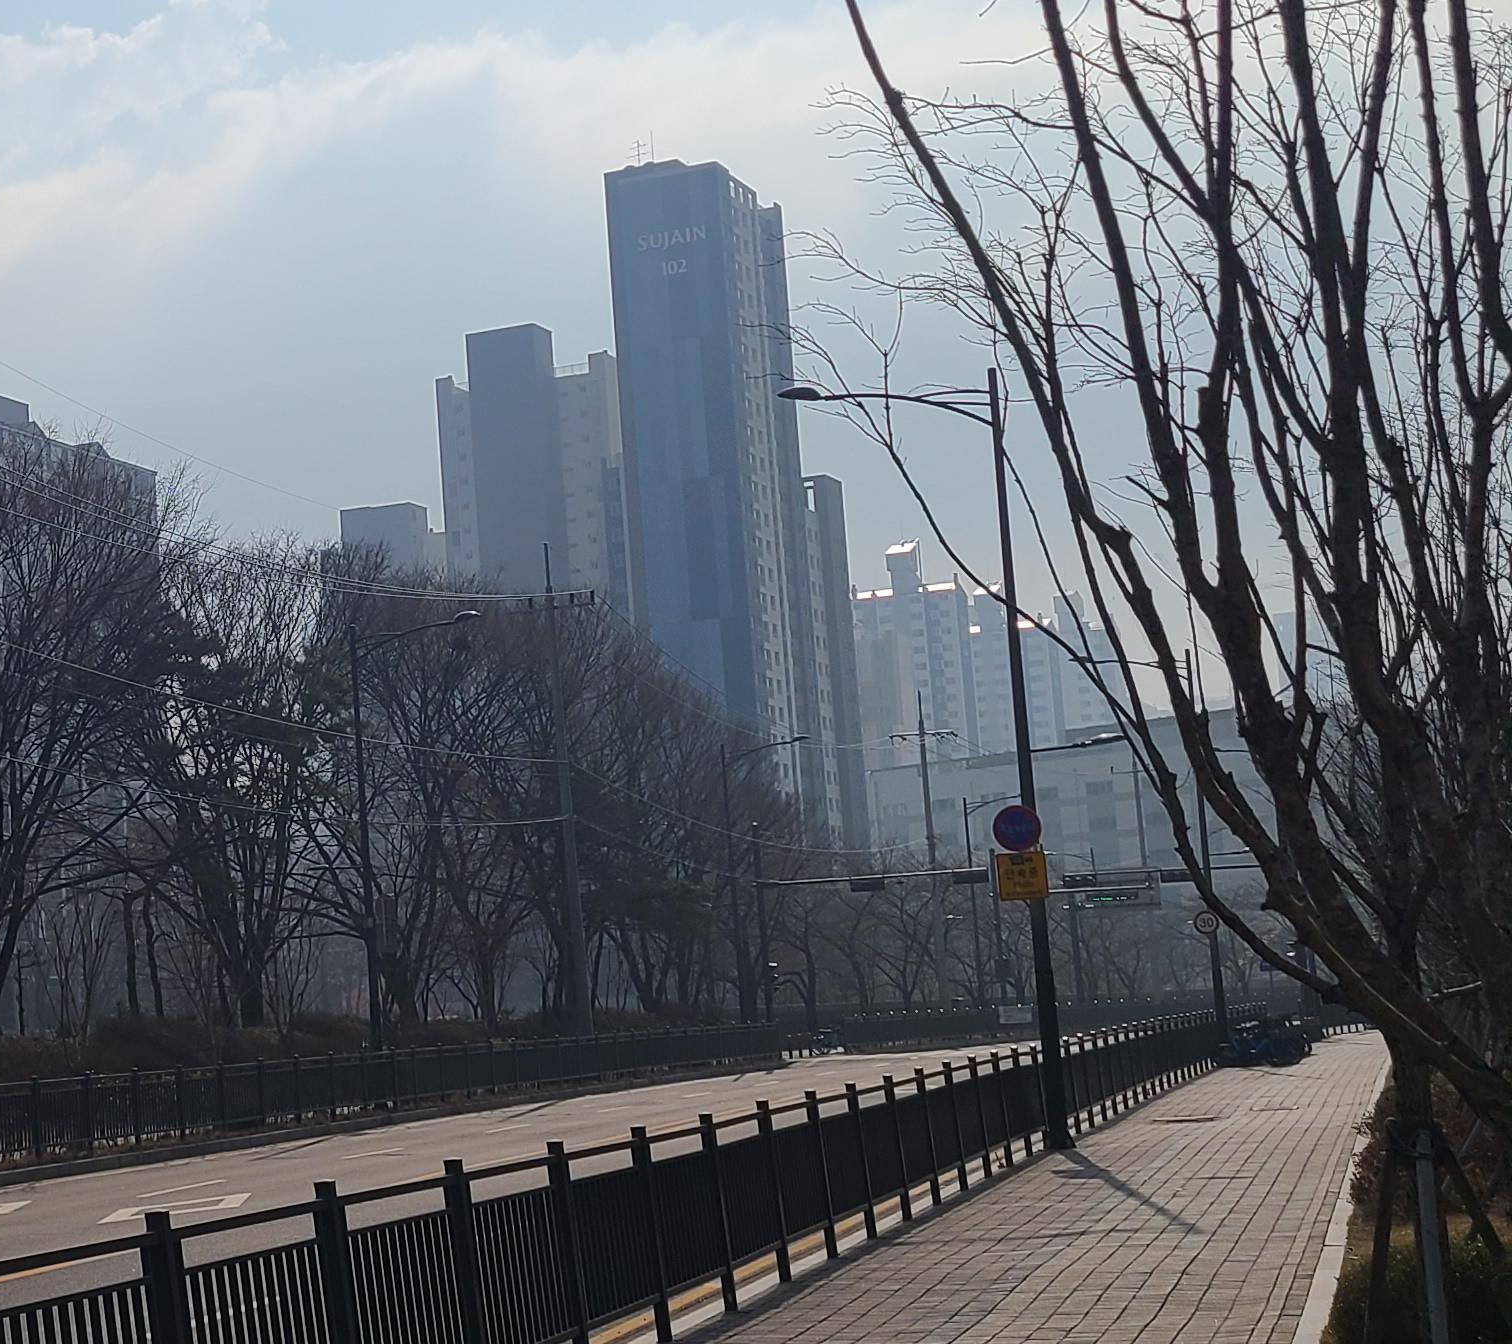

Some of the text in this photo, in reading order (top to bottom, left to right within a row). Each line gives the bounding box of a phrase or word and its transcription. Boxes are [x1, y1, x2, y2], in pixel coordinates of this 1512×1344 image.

[638, 224, 707, 252] SUJAIN
[662, 258, 688, 277] 102
[1199, 916, 1214, 929] 30
